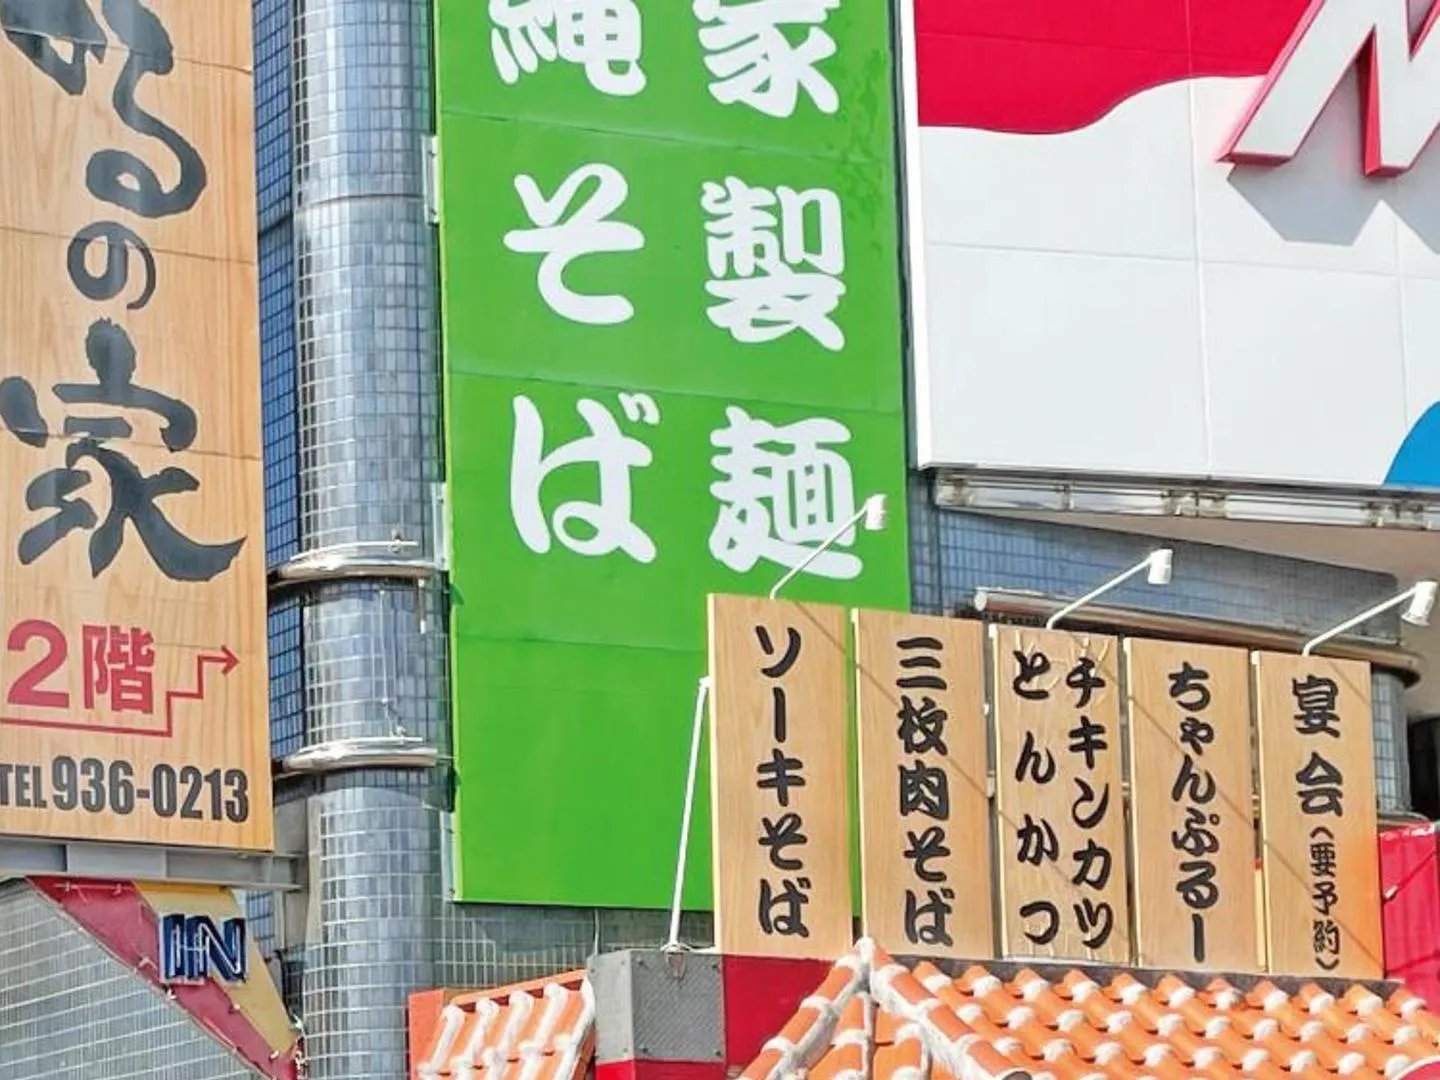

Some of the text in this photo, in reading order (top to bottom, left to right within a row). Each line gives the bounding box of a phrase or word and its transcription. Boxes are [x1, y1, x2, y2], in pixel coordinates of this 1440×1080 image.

[6, 619, 156, 715] 2階
[51, 755, 250, 824] 936-0213
[755, 625, 812, 938] ソーキそば
[895, 636, 956, 947] 三枚肉そば
[1013, 649, 1060, 945] とんかつ
[1065, 656, 1114, 950] チキンカツ
[1167, 660, 1221, 963] ちゃんぷるー
[162, 913, 247, 984] IN
